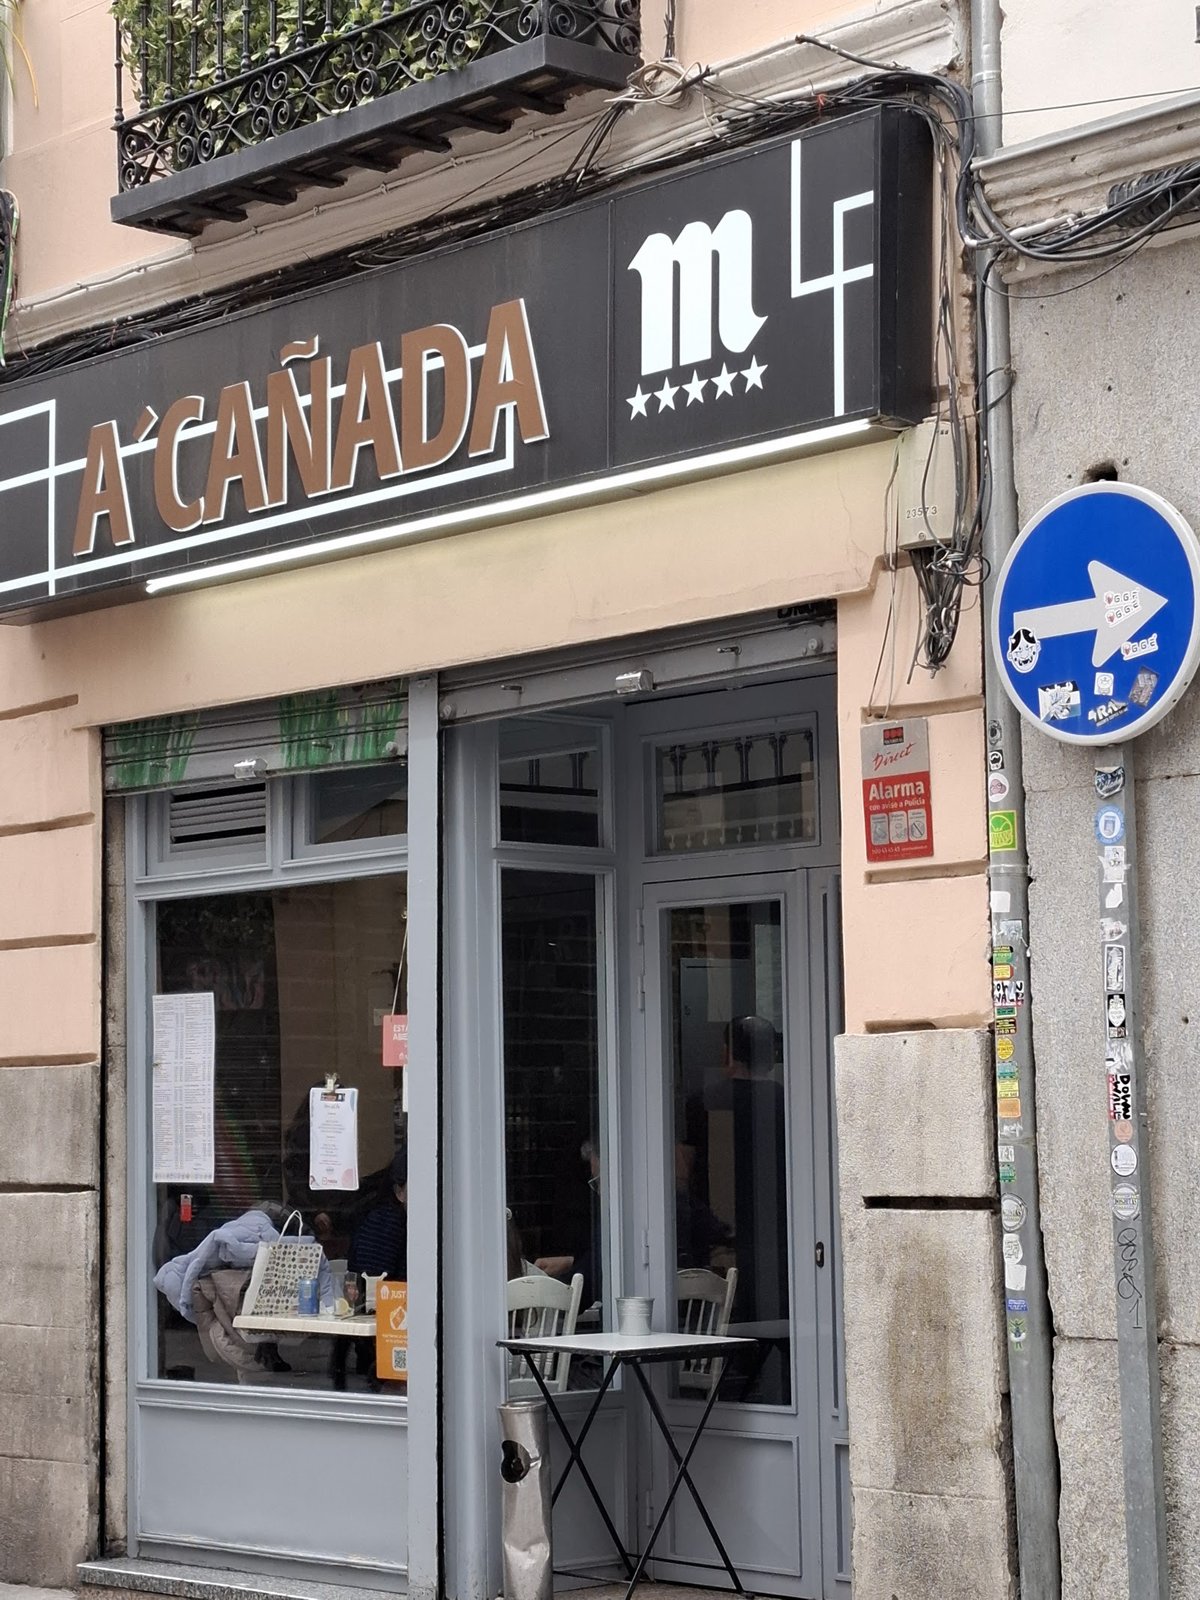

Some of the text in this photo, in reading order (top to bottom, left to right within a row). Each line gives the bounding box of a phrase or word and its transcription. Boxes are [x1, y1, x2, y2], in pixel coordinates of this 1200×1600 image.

[872, 742, 917, 772] Direct
[869, 781, 925, 801] Alarma
[391, 1290, 407, 1299] JUST
